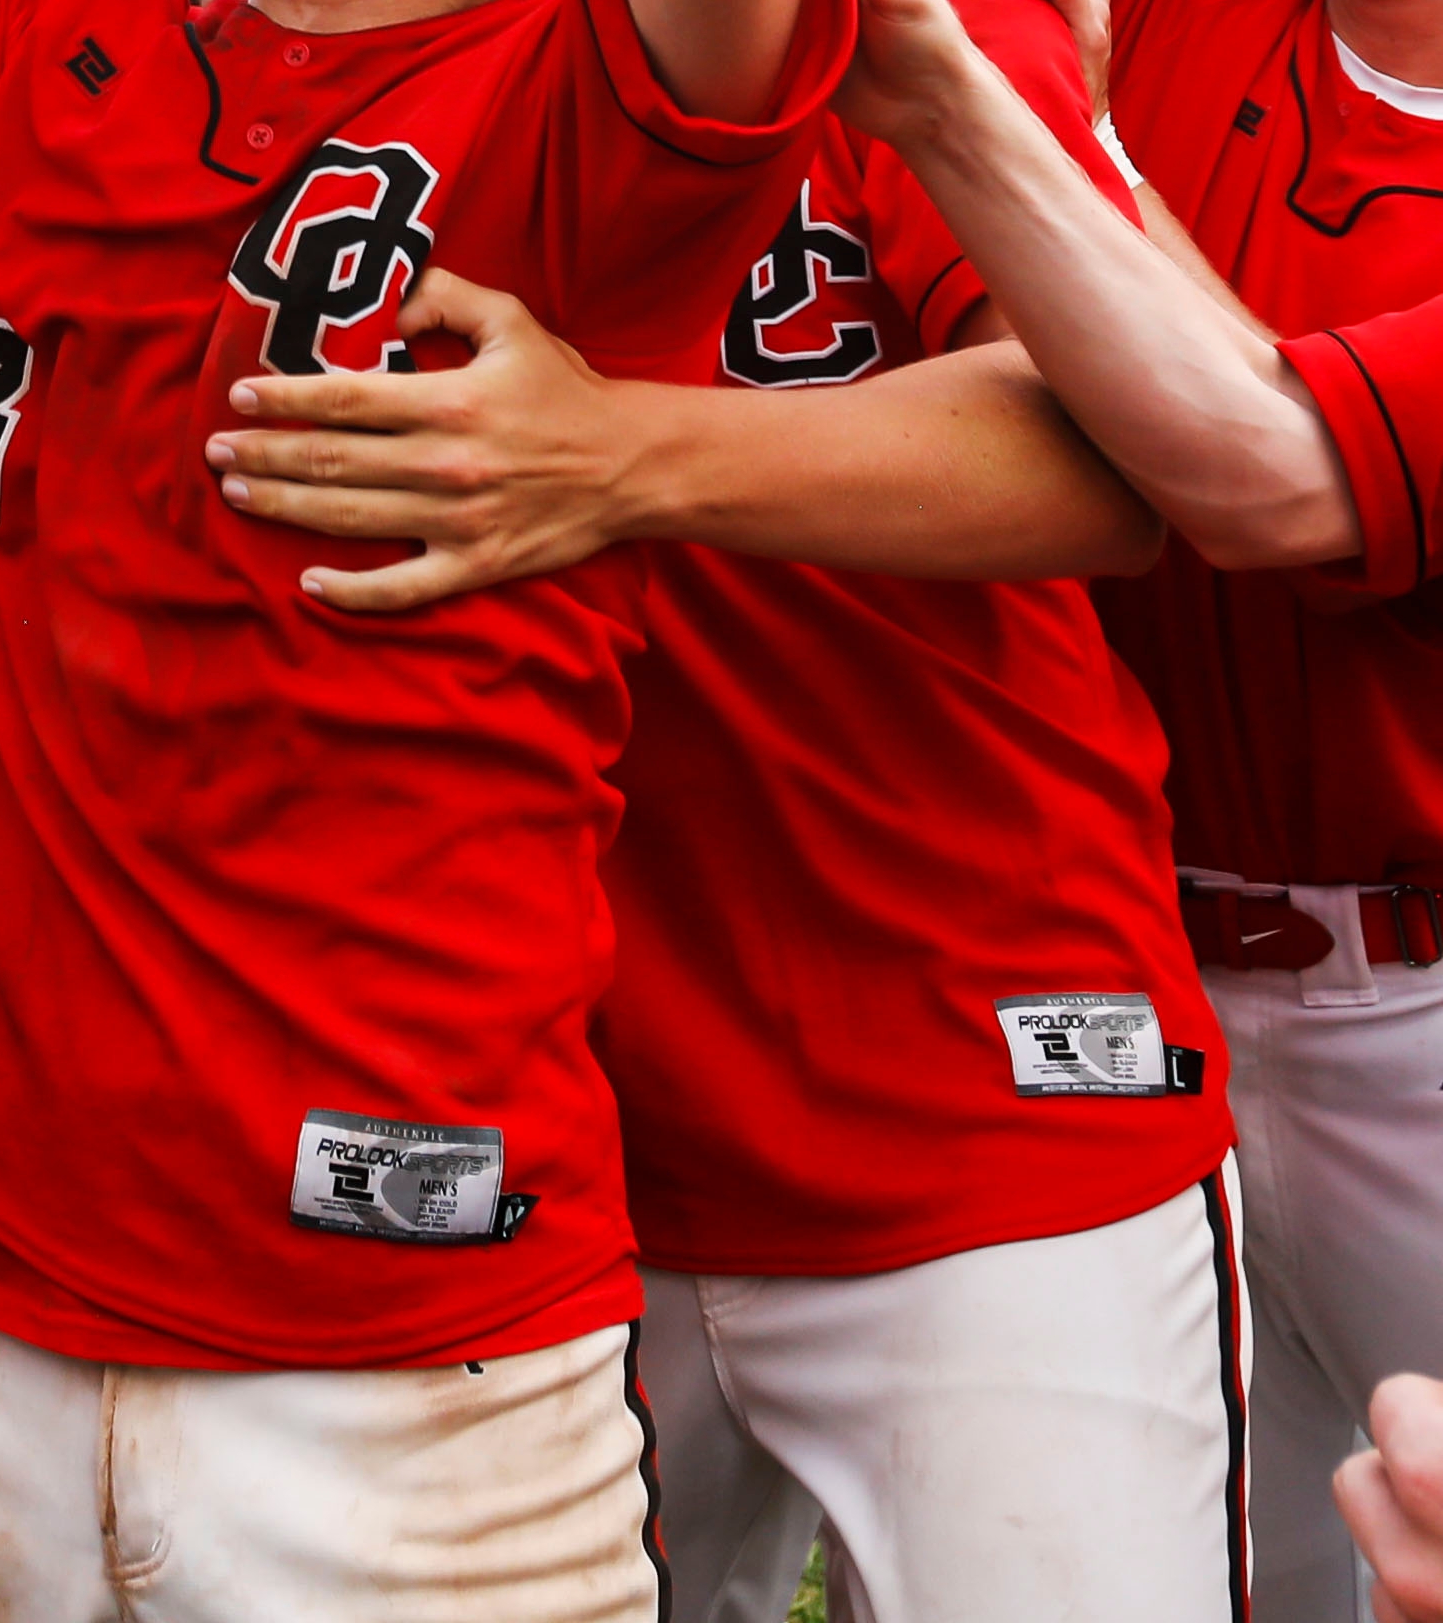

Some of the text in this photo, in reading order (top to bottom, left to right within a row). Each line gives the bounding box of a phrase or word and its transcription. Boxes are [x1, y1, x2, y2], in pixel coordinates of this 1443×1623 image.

[228, 137, 440, 377] OC
[1047, 997, 1108, 1006] AUTHENTIC
[1173, 1056, 1186, 1088] L
[365, 1122, 444, 1142] AUTHENTIC
[419, 1178, 458, 1197] MEN'S
